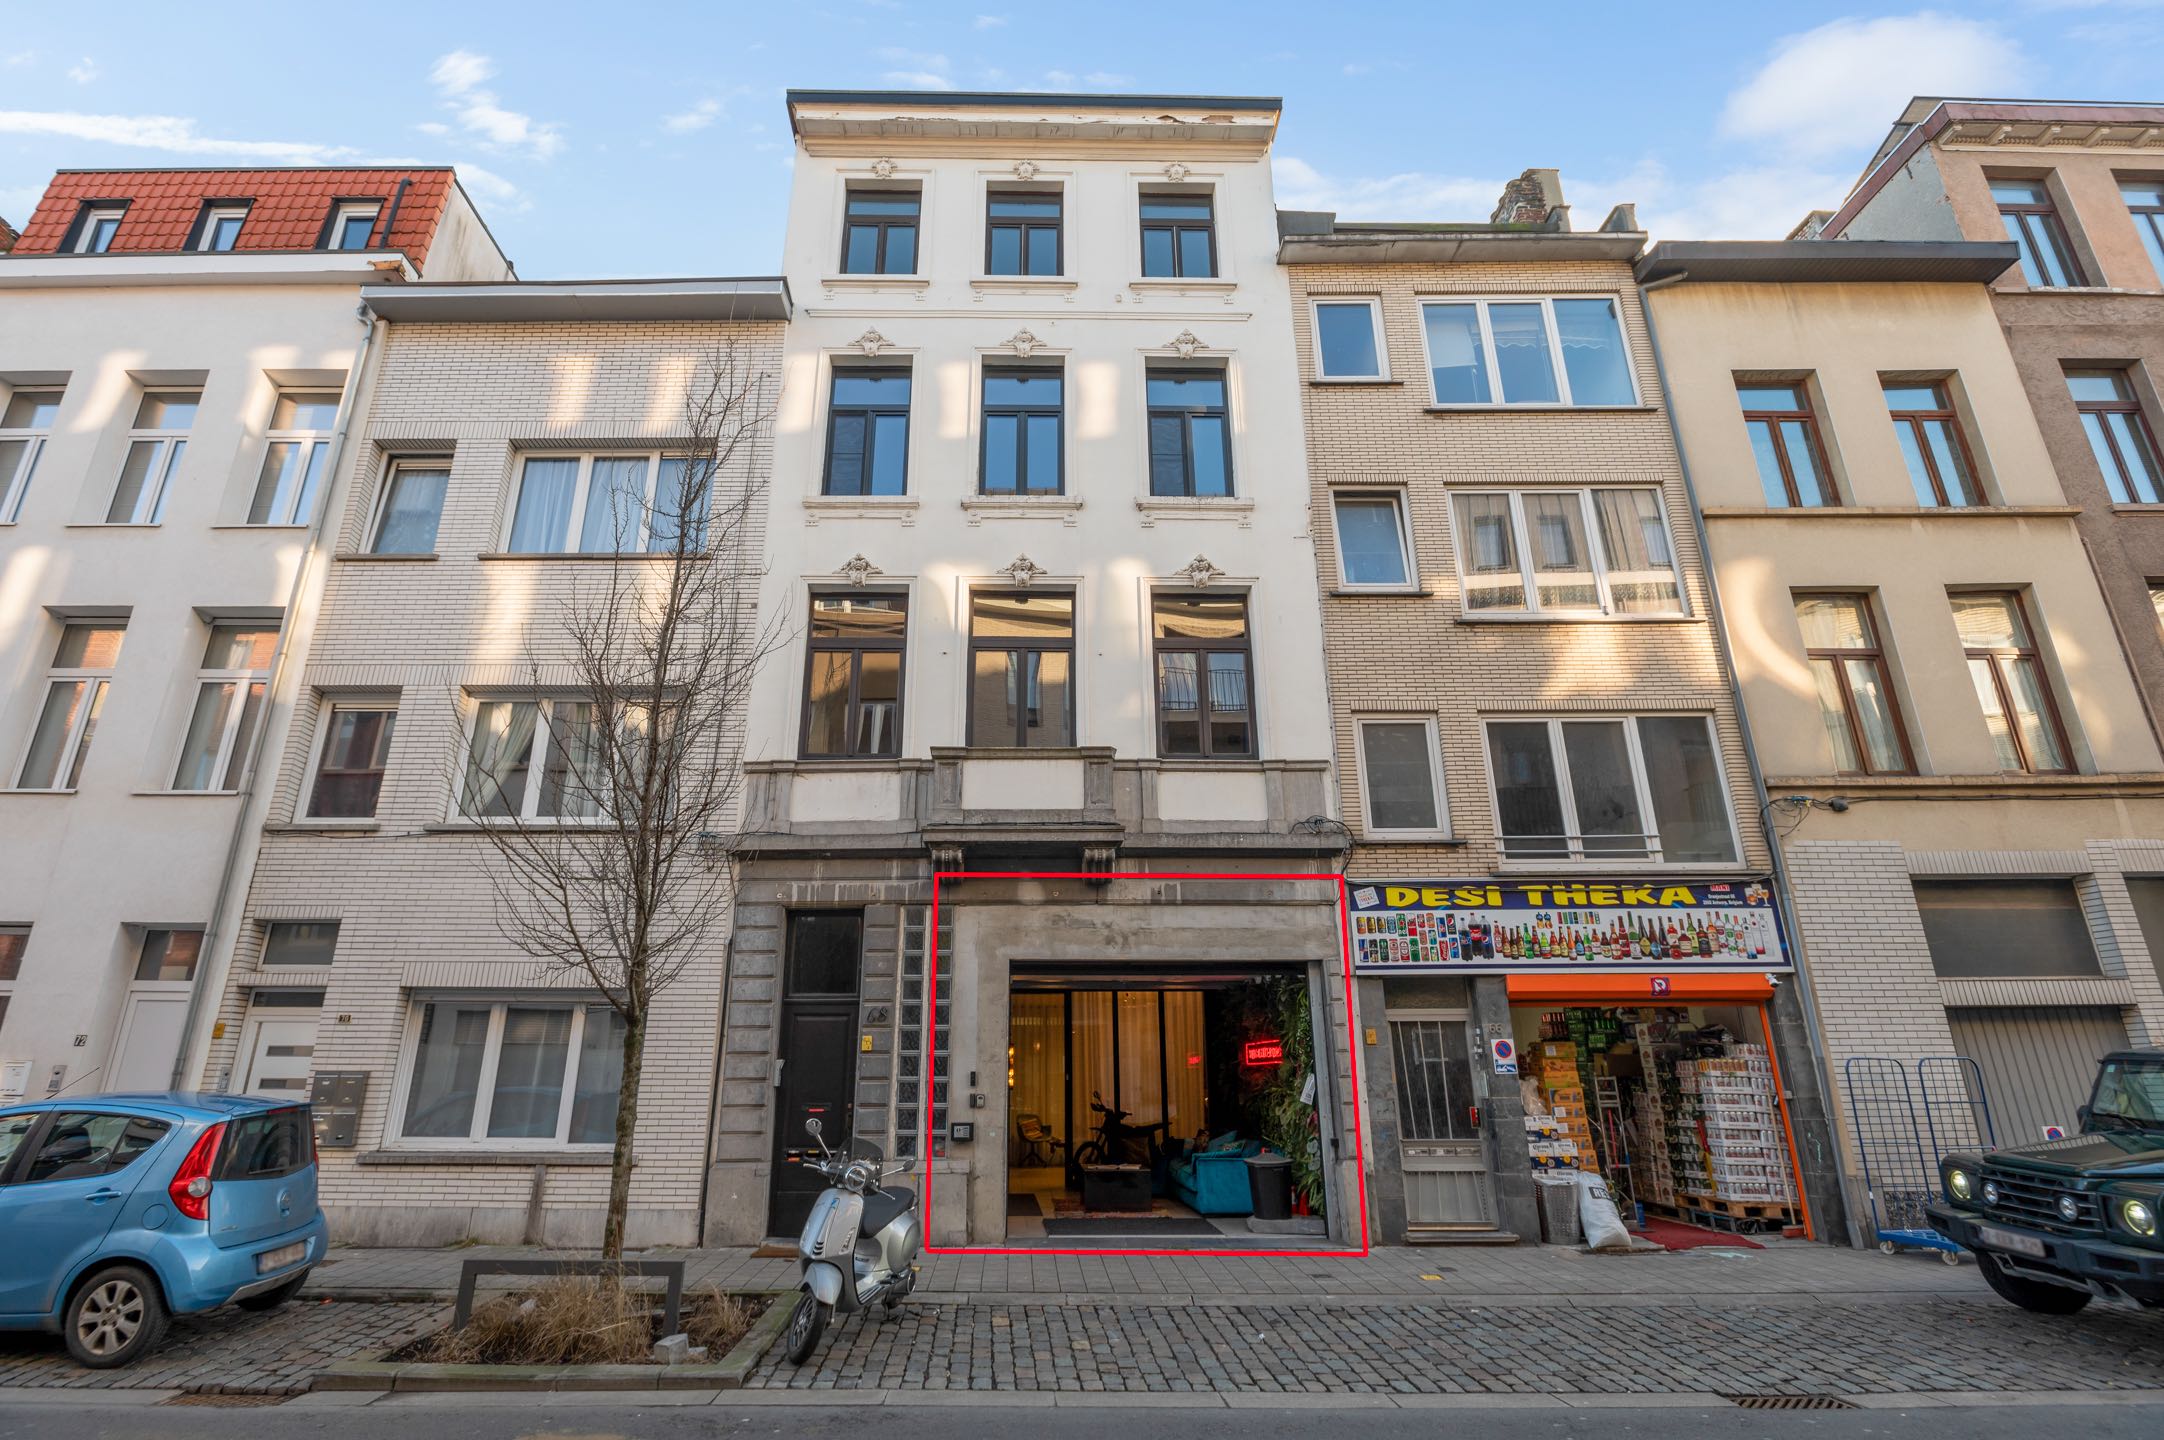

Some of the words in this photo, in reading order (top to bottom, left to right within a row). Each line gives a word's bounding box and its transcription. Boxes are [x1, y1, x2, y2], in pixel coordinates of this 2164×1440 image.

[1385, 885, 1502, 907] DESI
[1517, 883, 1697, 906] THEKA
[867, 1007, 887, 1023] 68
[1490, 1023, 1502, 1034] 66
[74, 1034, 88, 1046] 72
